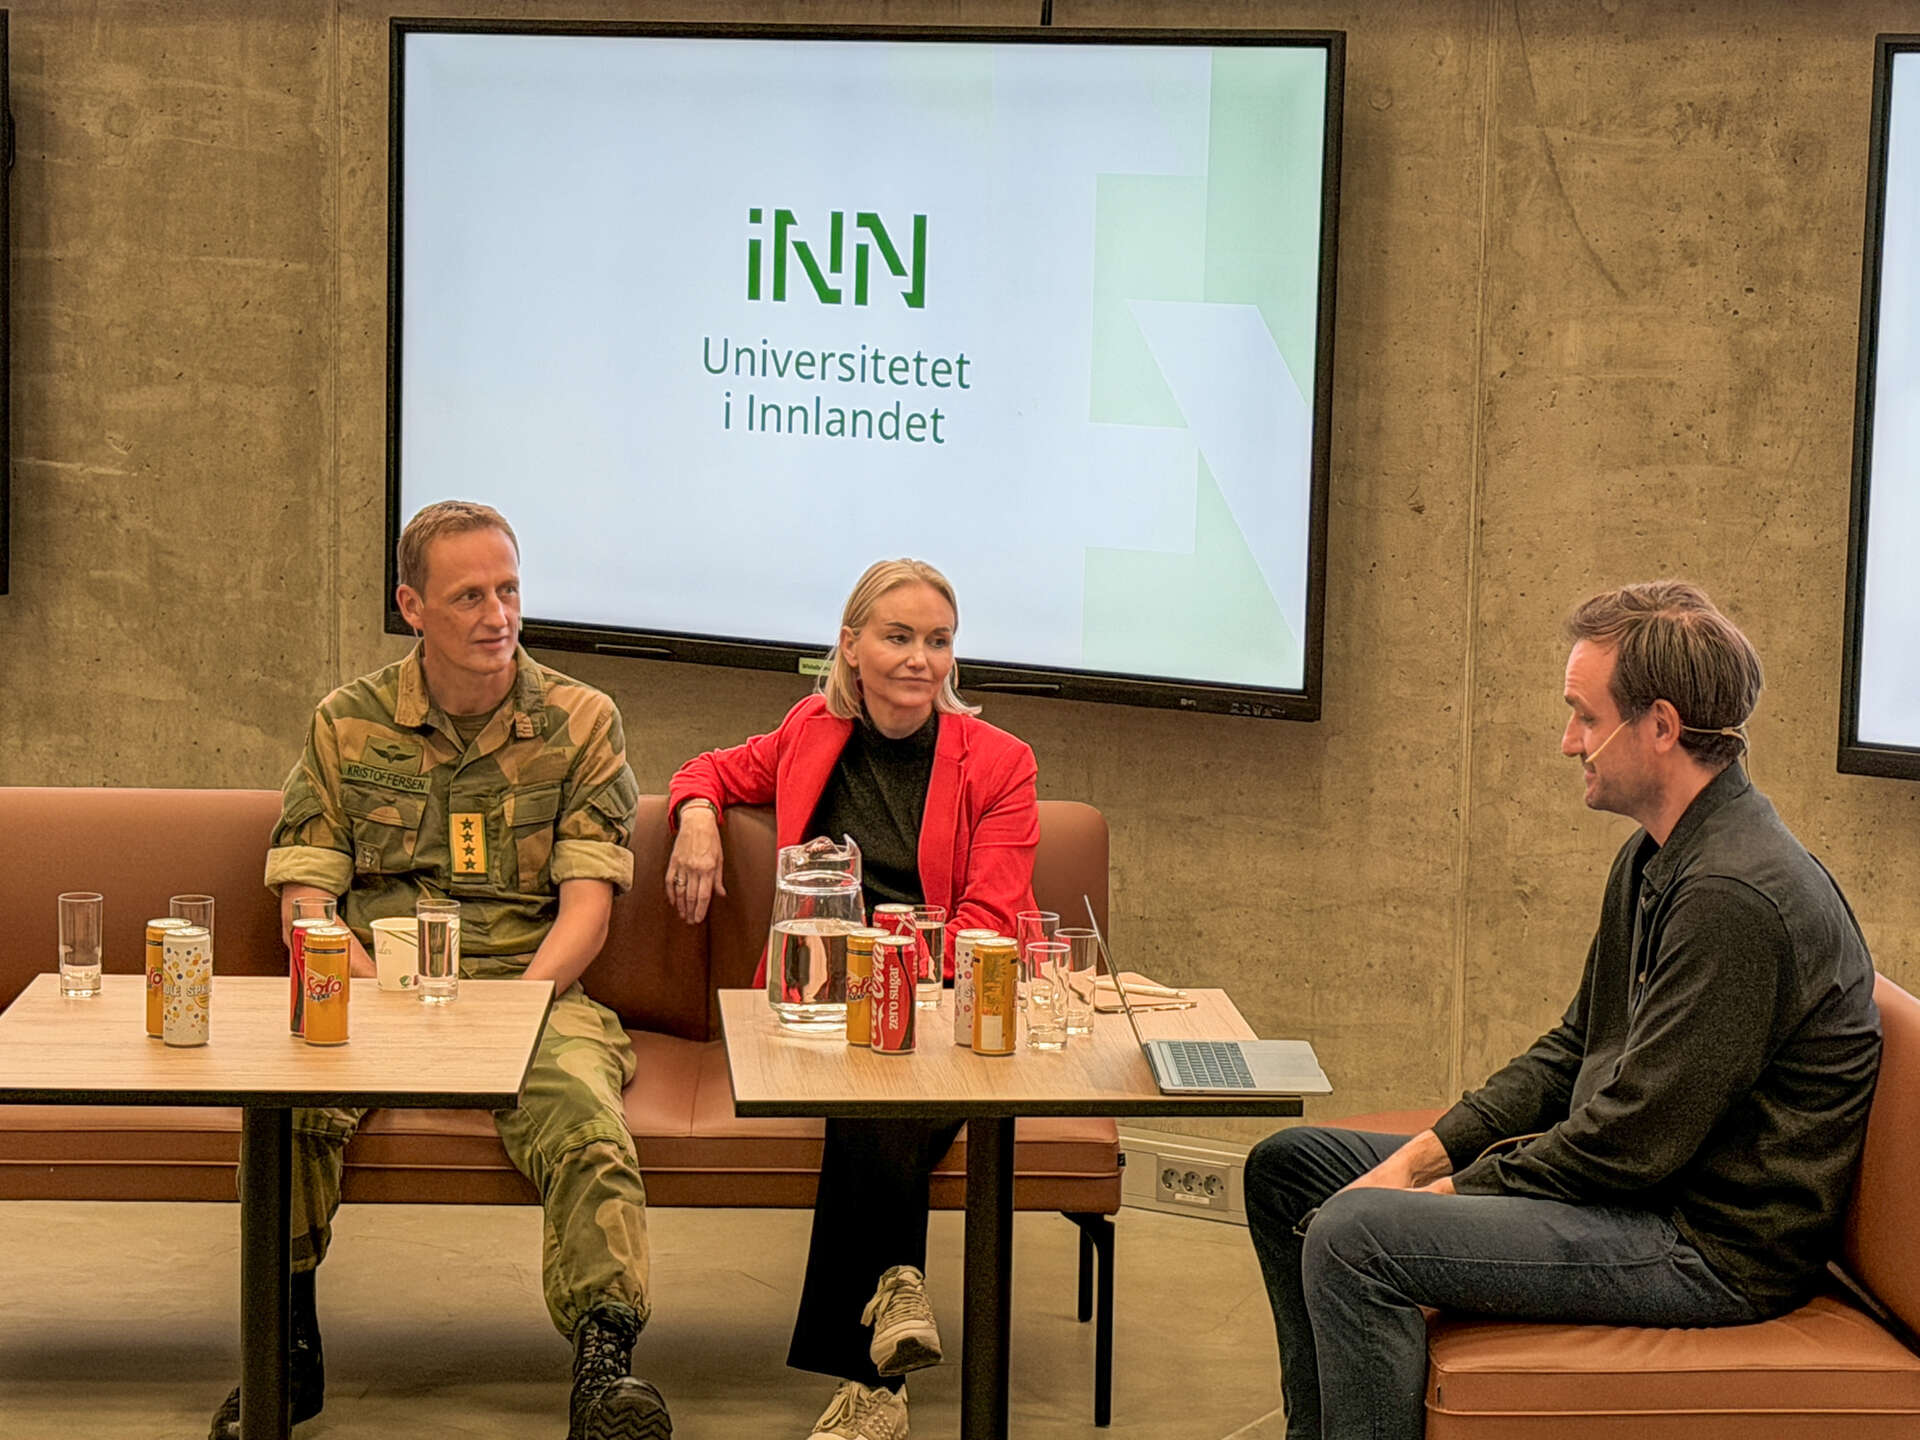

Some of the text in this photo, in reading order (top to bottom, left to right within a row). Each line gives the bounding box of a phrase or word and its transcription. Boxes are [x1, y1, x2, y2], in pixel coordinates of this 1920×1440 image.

[703, 336, 971, 389] Universitetet
[724, 391, 945, 444] i Innlandet
[347, 763, 426, 791] KRISTOFFERSEN
[889, 965, 901, 1030] zero sugar
